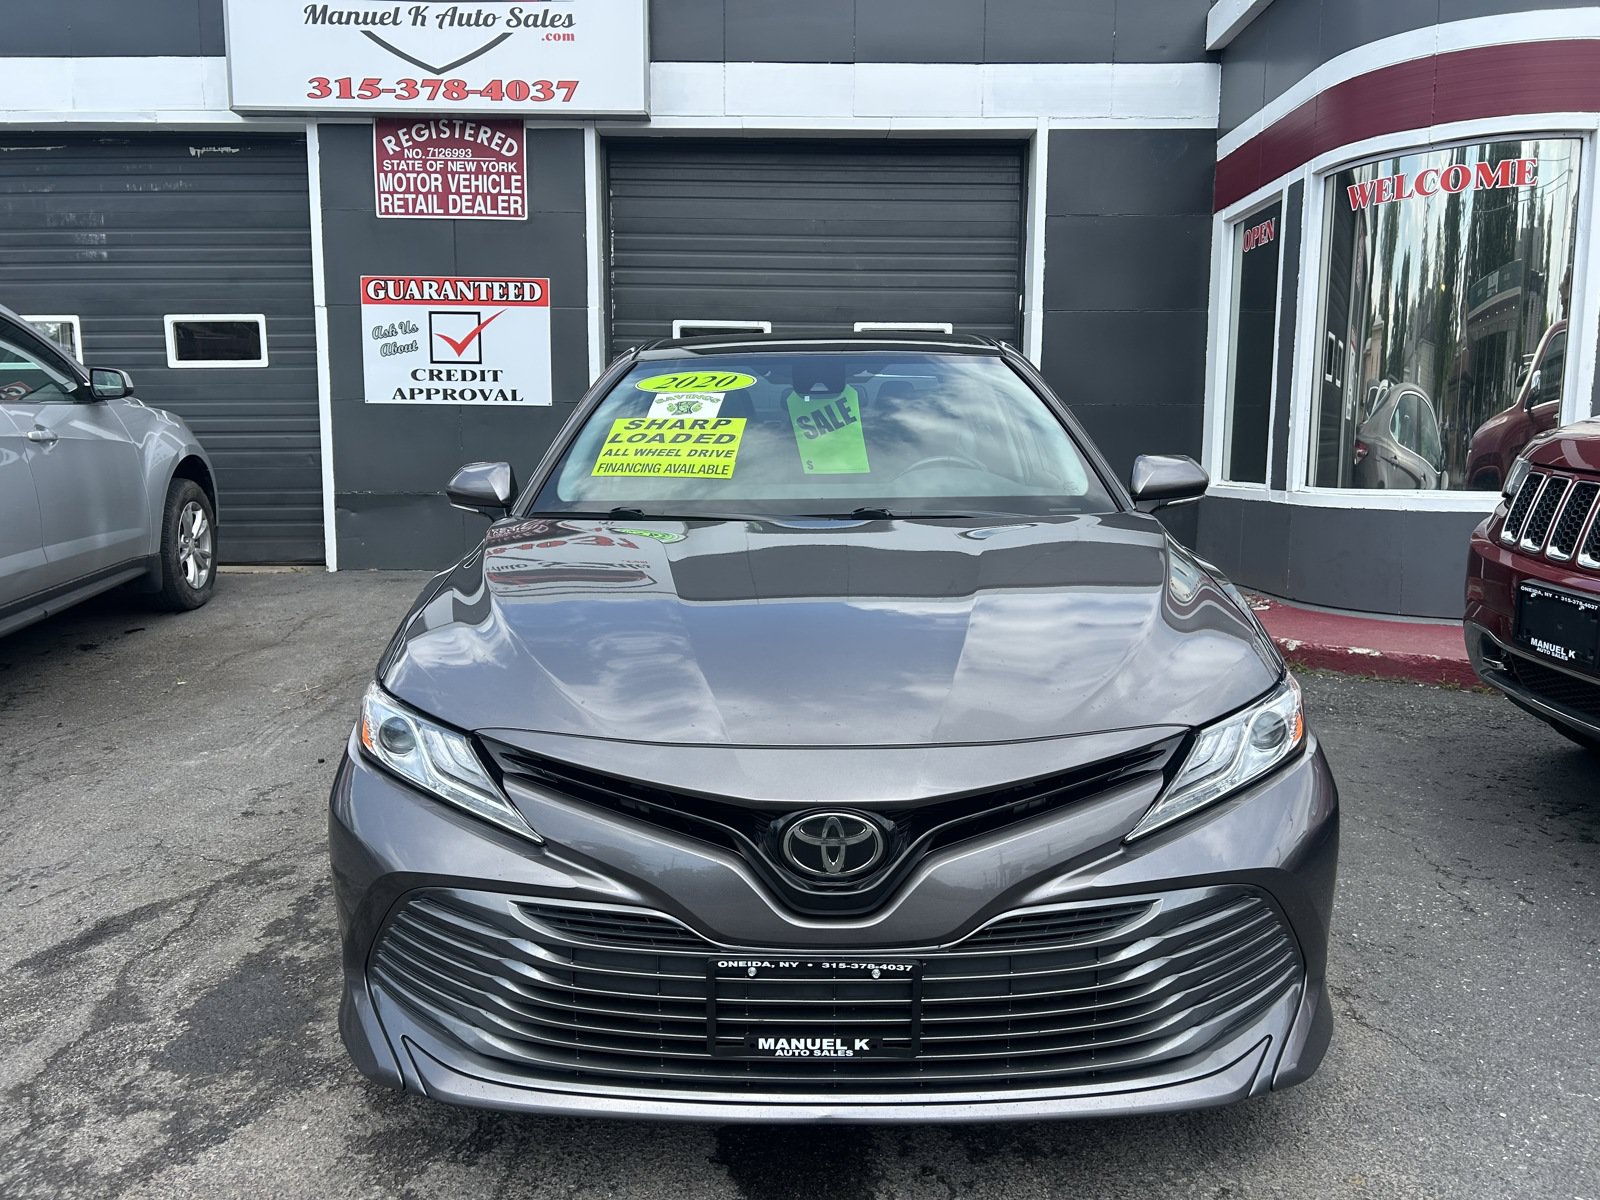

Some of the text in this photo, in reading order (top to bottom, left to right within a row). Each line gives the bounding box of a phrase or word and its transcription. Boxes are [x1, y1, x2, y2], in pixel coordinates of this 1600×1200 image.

[303, 4, 576, 29] Manuel K Auto Sales
[541, 33, 575, 42] .com
[306, 76, 579, 102] 315-378-4037
[382, 119, 518, 157] REGISTERED
[404, 147, 472, 159] NO. 7126993
[383, 160, 517, 173] STATE OF NEW YORK
[379, 173, 522, 194] MOTOR VEHICLE
[1347, 158, 1539, 211] WELCOME
[380, 194, 523, 215] RETAIL DEALER
[1243, 217, 1276, 253] OPEN
[366, 280, 542, 301] GUARANTEED
[372, 320, 419, 340] Ask Us
[380, 340, 419, 357] About
[410, 368, 503, 382] CREDIT
[653, 375, 738, 390] 2020
[392, 387, 523, 402] APPROVAL
[624, 419, 732, 431] SHARP
[796, 397, 858, 440] SALE
[607, 433, 737, 444] LOADED
[603, 448, 735, 459] ALL WHEEL DRIVE
[597, 462, 730, 476] FINANCING AVAILABLE
[1530, 637, 1576, 659] MANUEL K
[717, 961, 775, 969] ONEIDA,
[821, 962, 913, 972] 315-378-4037
[757, 1037, 870, 1050] MANUEL K
